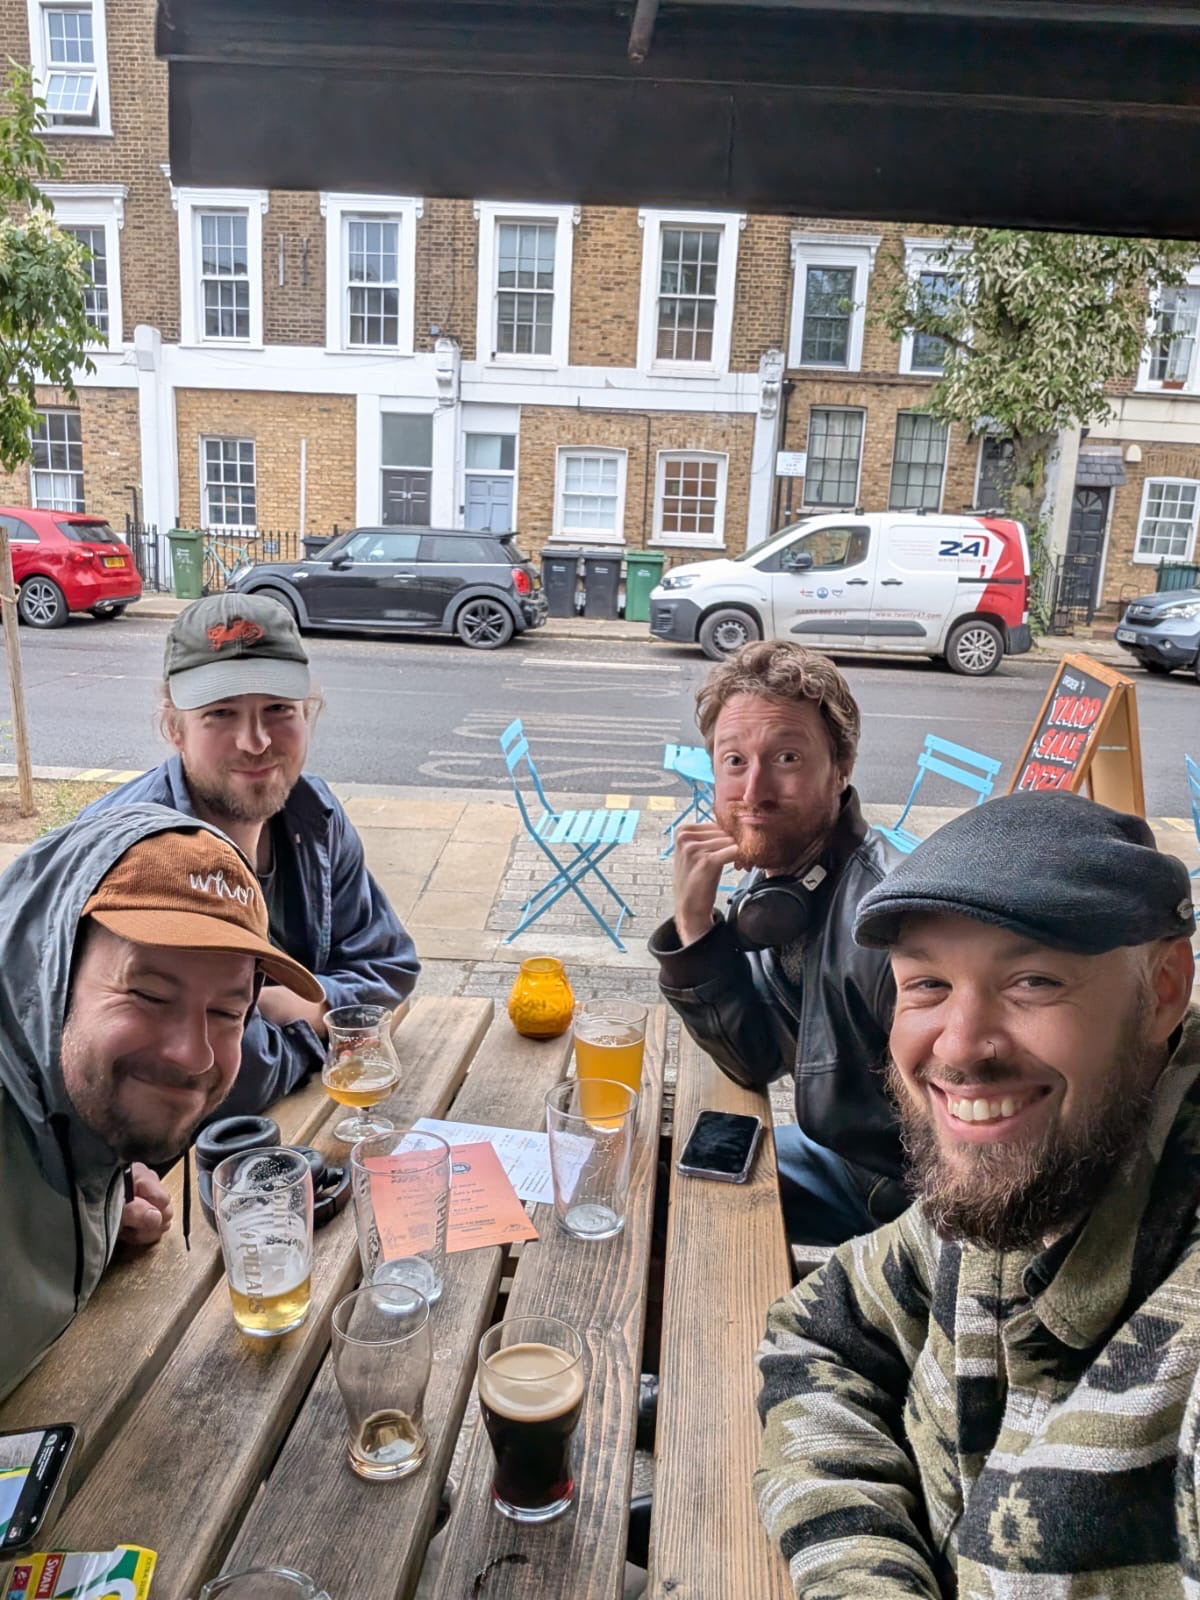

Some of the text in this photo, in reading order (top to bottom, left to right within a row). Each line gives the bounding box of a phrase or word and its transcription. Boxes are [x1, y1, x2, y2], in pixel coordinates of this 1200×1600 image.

[1047, 695, 1102, 728] YARD
[1037, 729, 1087, 765] SALE
[1018, 761, 1076, 791] PIZZA
[38, 1558, 55, 1593] SWAN
